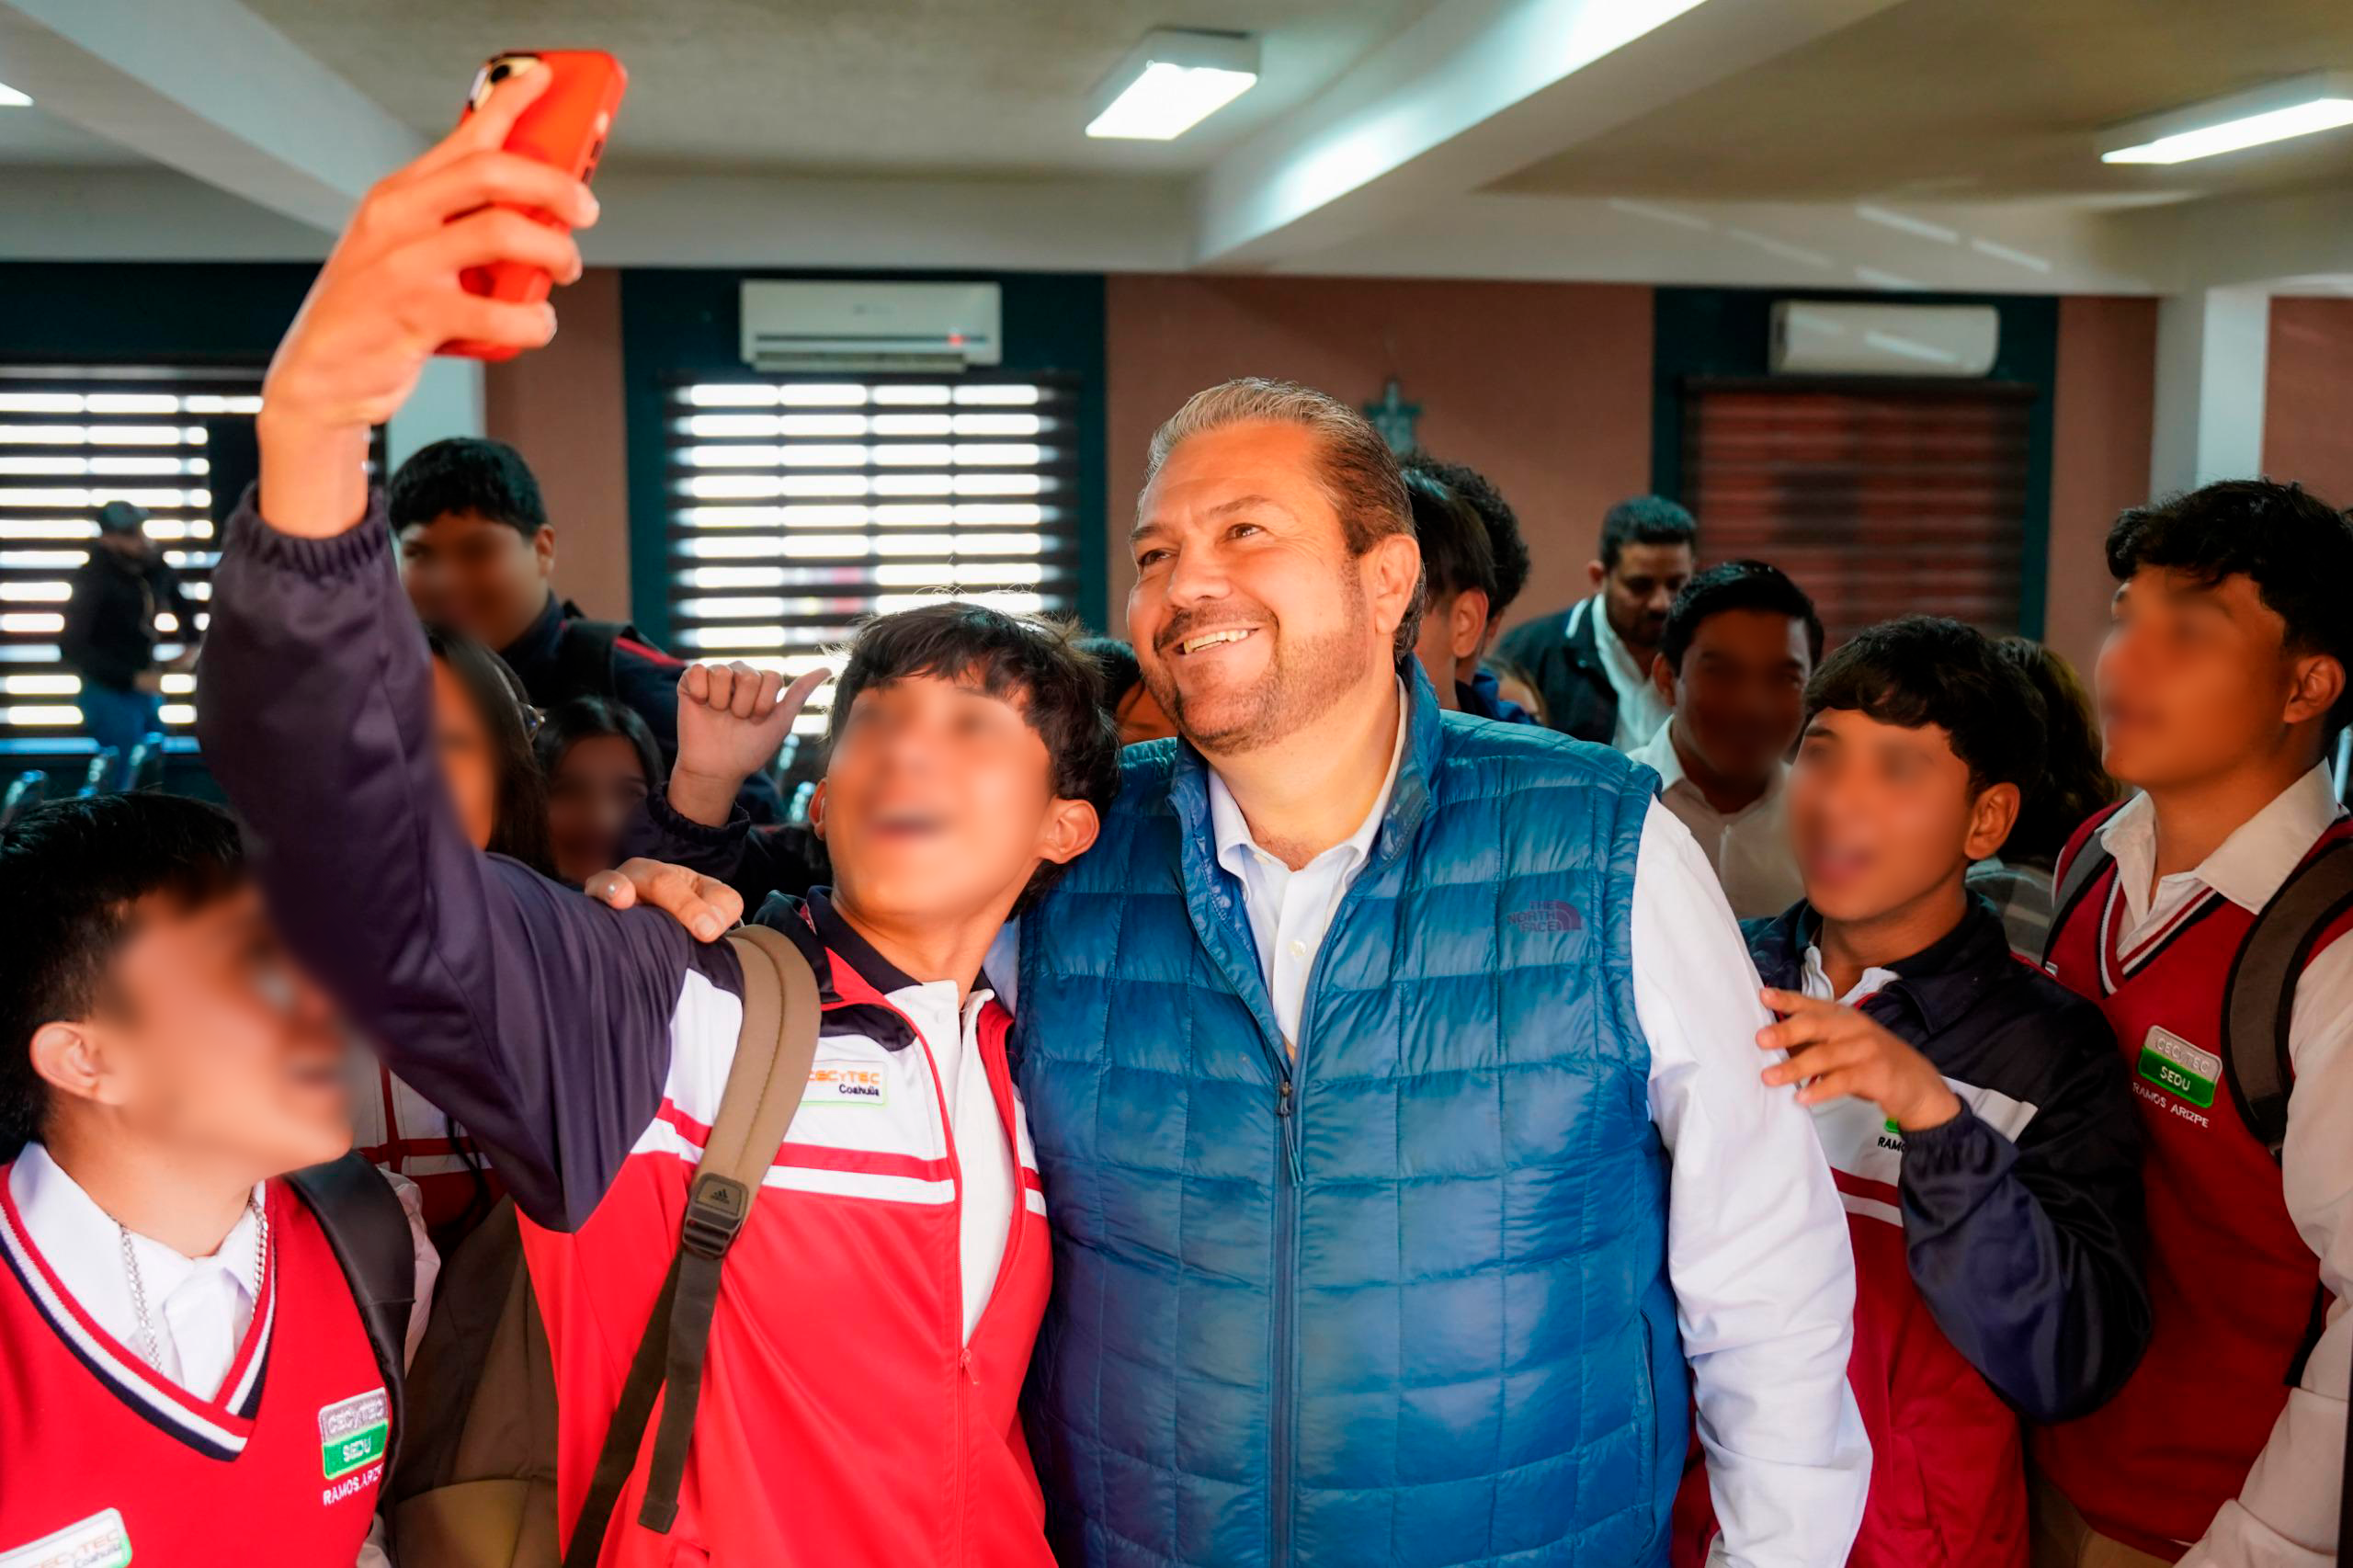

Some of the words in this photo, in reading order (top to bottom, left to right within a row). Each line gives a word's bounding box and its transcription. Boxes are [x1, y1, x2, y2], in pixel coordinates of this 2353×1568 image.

[1529, 900, 1560, 911] THE
[1519, 921, 1561, 932] FACE
[2160, 1066, 2190, 1091] SEDU
[838, 1084, 880, 1096] Coahuila
[2132, 1082, 2167, 1108] RAMOS
[2170, 1104, 2210, 1128] ARIZPE
[343, 1436, 371, 1462] SEDU
